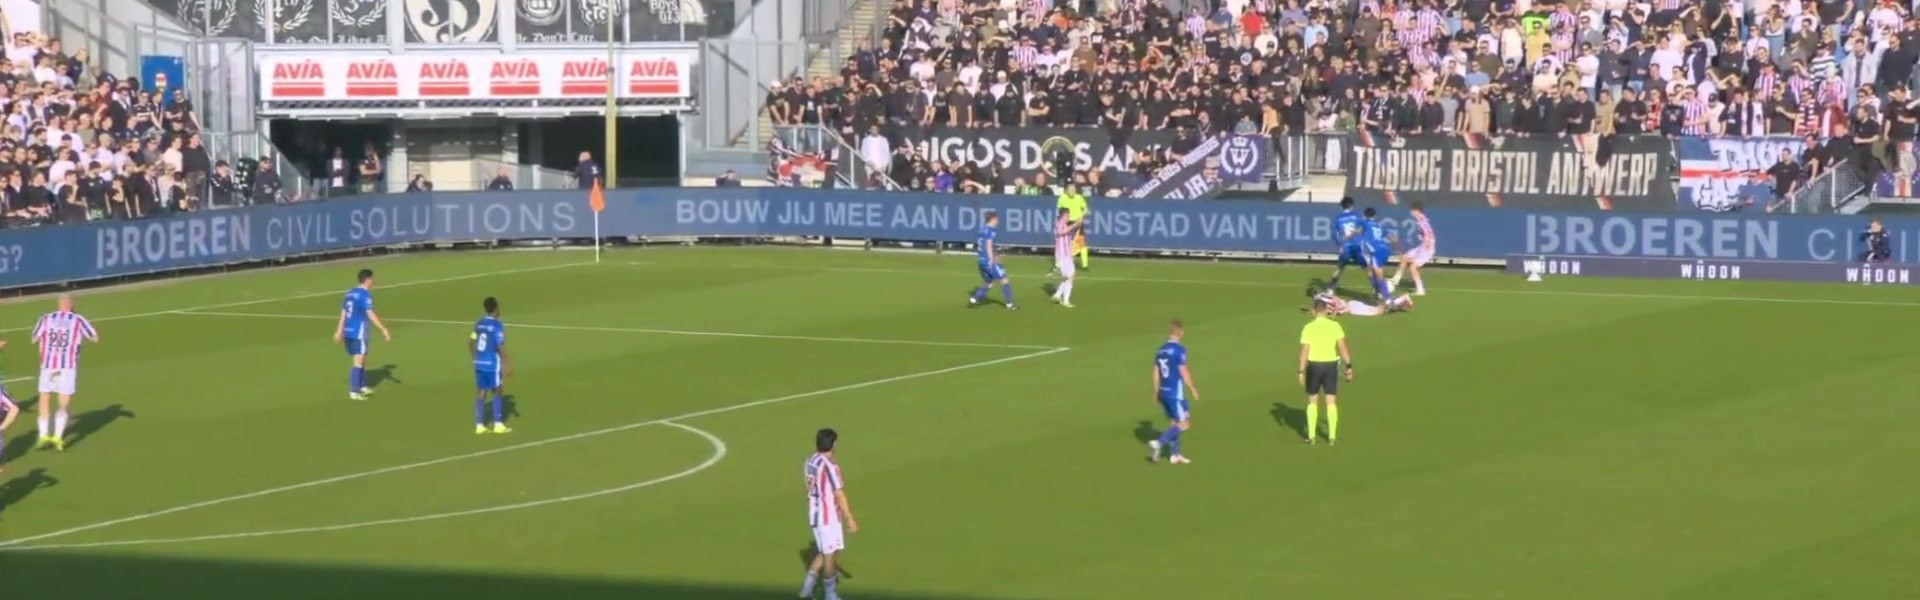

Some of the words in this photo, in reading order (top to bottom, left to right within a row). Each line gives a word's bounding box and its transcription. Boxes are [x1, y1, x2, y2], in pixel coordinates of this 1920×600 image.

[1353, 145, 1443, 191] TILBURG
[1450, 149, 1540, 195] BRISTOL
[1546, 152, 1658, 197] ANTWERP
[96, 213, 250, 270] BROEREN
[266, 212, 338, 249] CIVIL
[350, 201, 576, 240] SOLUTIONS
[676, 199, 769, 224] BOUW
[778, 203, 815, 226] JIJ
[824, 202, 883, 227] MEE
[891, 204, 949, 231] AAN
[1200, 211, 1258, 241] VAN
[1526, 214, 1779, 259] BROEREN
[477, 332, 487, 352] 6
